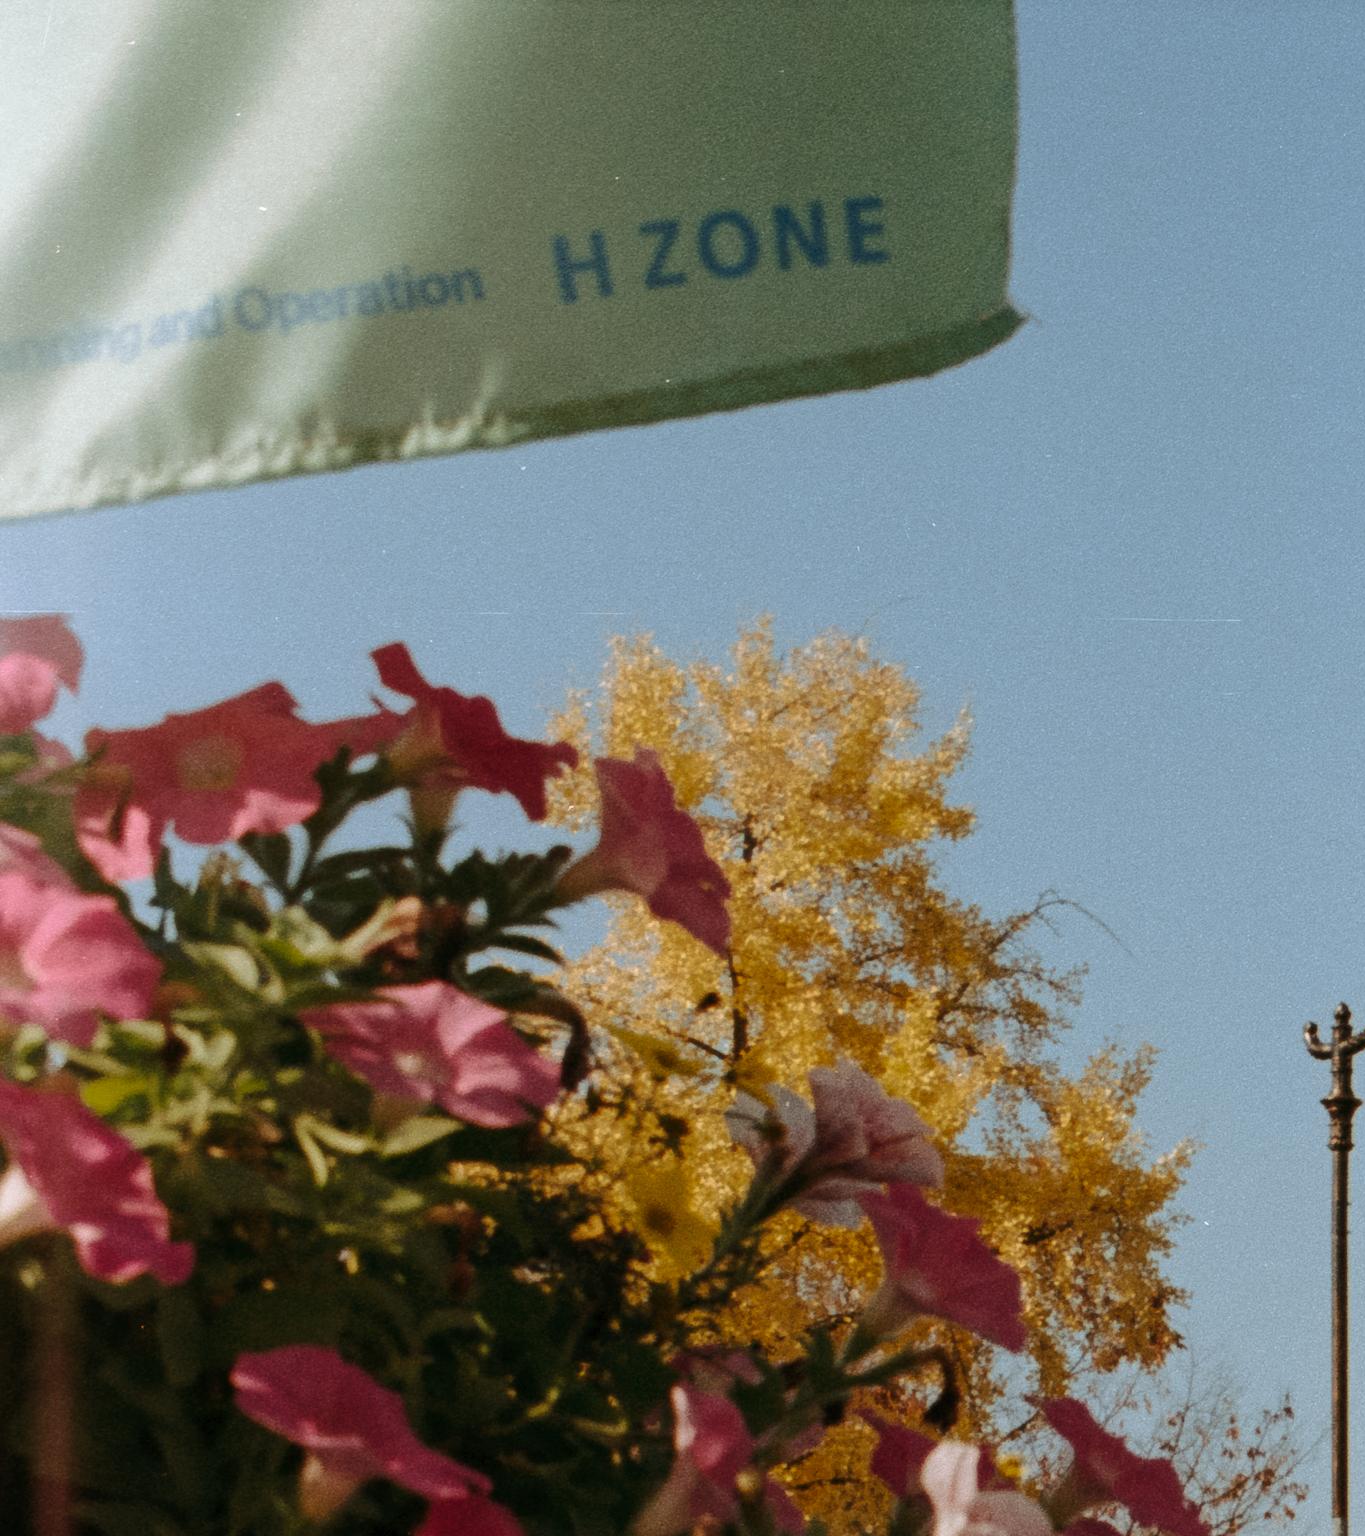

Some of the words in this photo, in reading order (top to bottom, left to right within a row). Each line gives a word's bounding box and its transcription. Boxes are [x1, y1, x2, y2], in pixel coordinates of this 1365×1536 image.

[553, 227, 615, 305] H
[638, 195, 891, 290] ZONE
[148, 292, 226, 348] and
[233, 264, 487, 335] Operation
